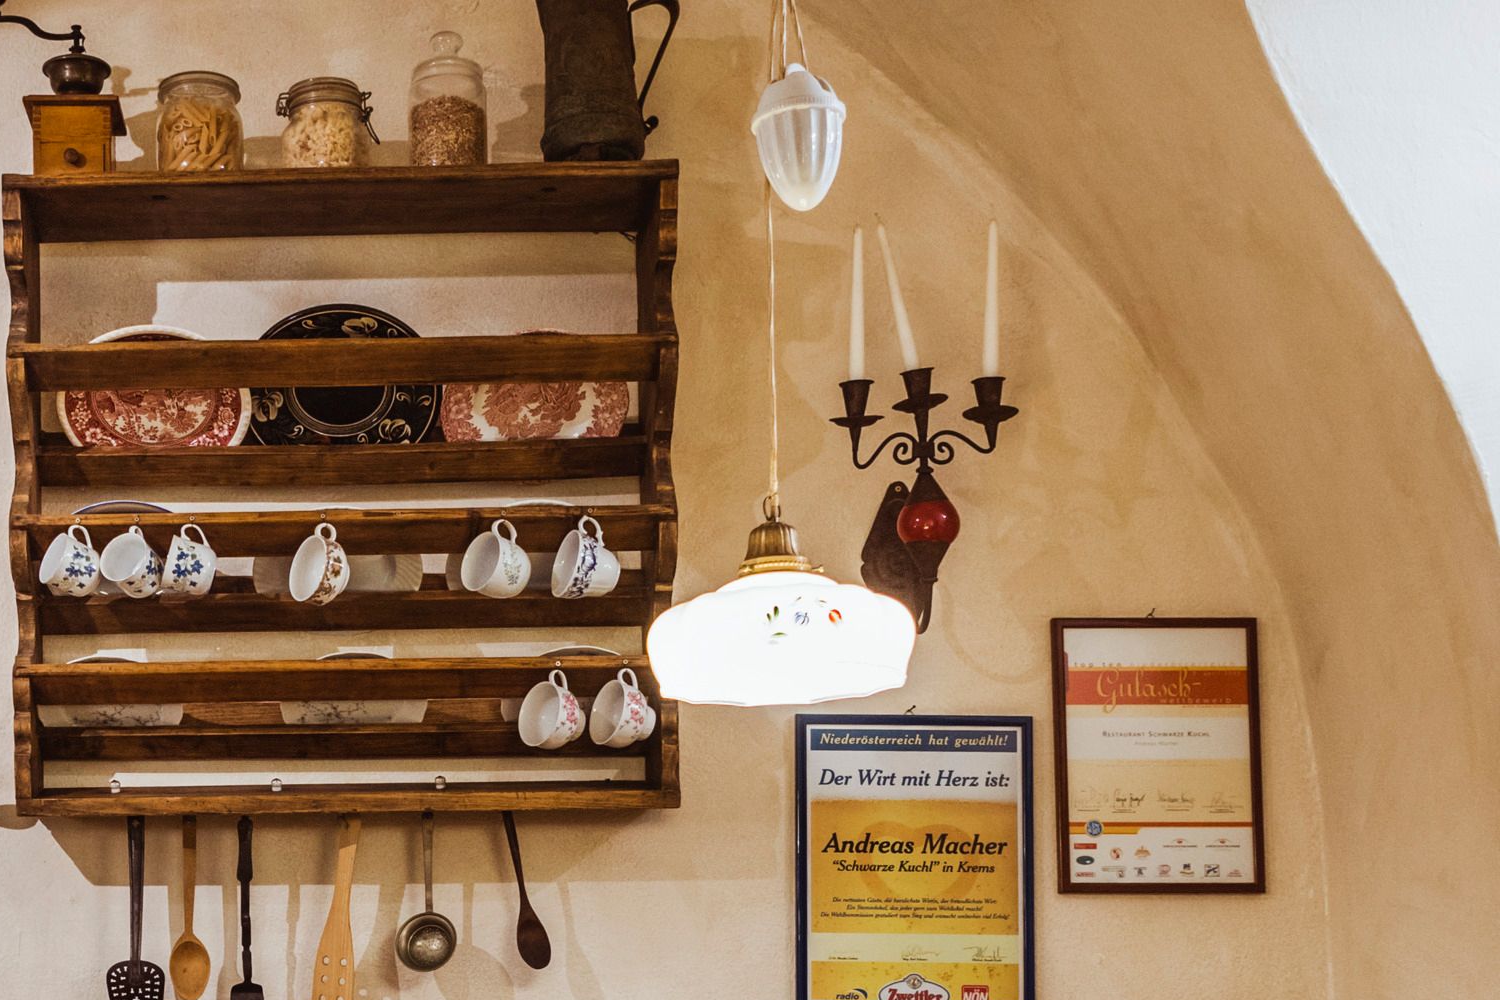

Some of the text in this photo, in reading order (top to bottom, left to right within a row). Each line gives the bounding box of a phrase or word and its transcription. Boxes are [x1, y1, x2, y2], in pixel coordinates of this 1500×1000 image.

[819, 733, 1009, 748] Niederösterreich hat gewählt!
[818, 768, 1010, 787] Der Wirt mit Herz ist:
[821, 832, 1008, 855] Andreas Macher
[942, 863, 954, 873] in
[957, 862, 996, 873] Krems
[836, 992, 860, 1000] radio
